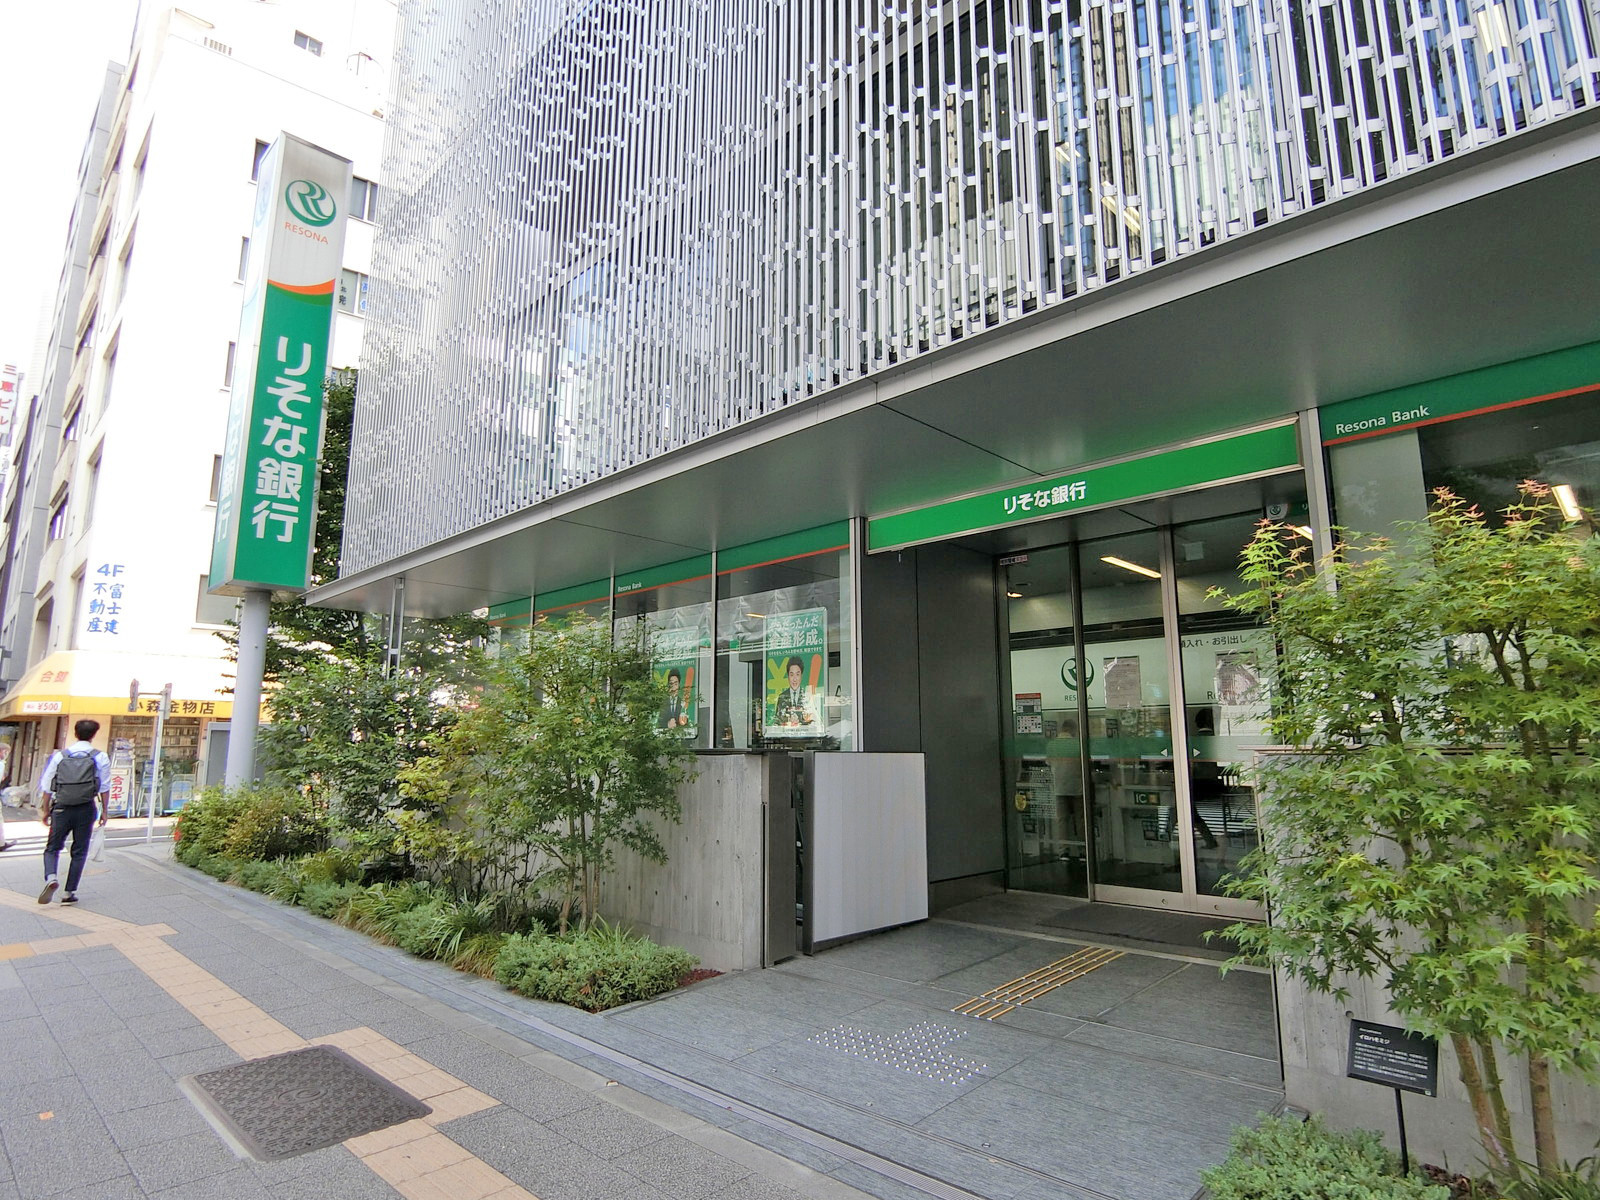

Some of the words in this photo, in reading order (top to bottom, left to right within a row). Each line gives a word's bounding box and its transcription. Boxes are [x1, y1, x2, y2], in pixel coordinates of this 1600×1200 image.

[285, 221, 329, 244] RESONA
[1335, 416, 1386, 435] Resona
[1391, 405, 1430, 423] Bank
[252, 335, 311, 543] りそな銀行
[1003, 481, 1087, 514] りそな銀行
[97, 563, 125, 577] 4F
[87, 582, 107, 633] 不動産
[1064, 694, 1094, 702] RESA
